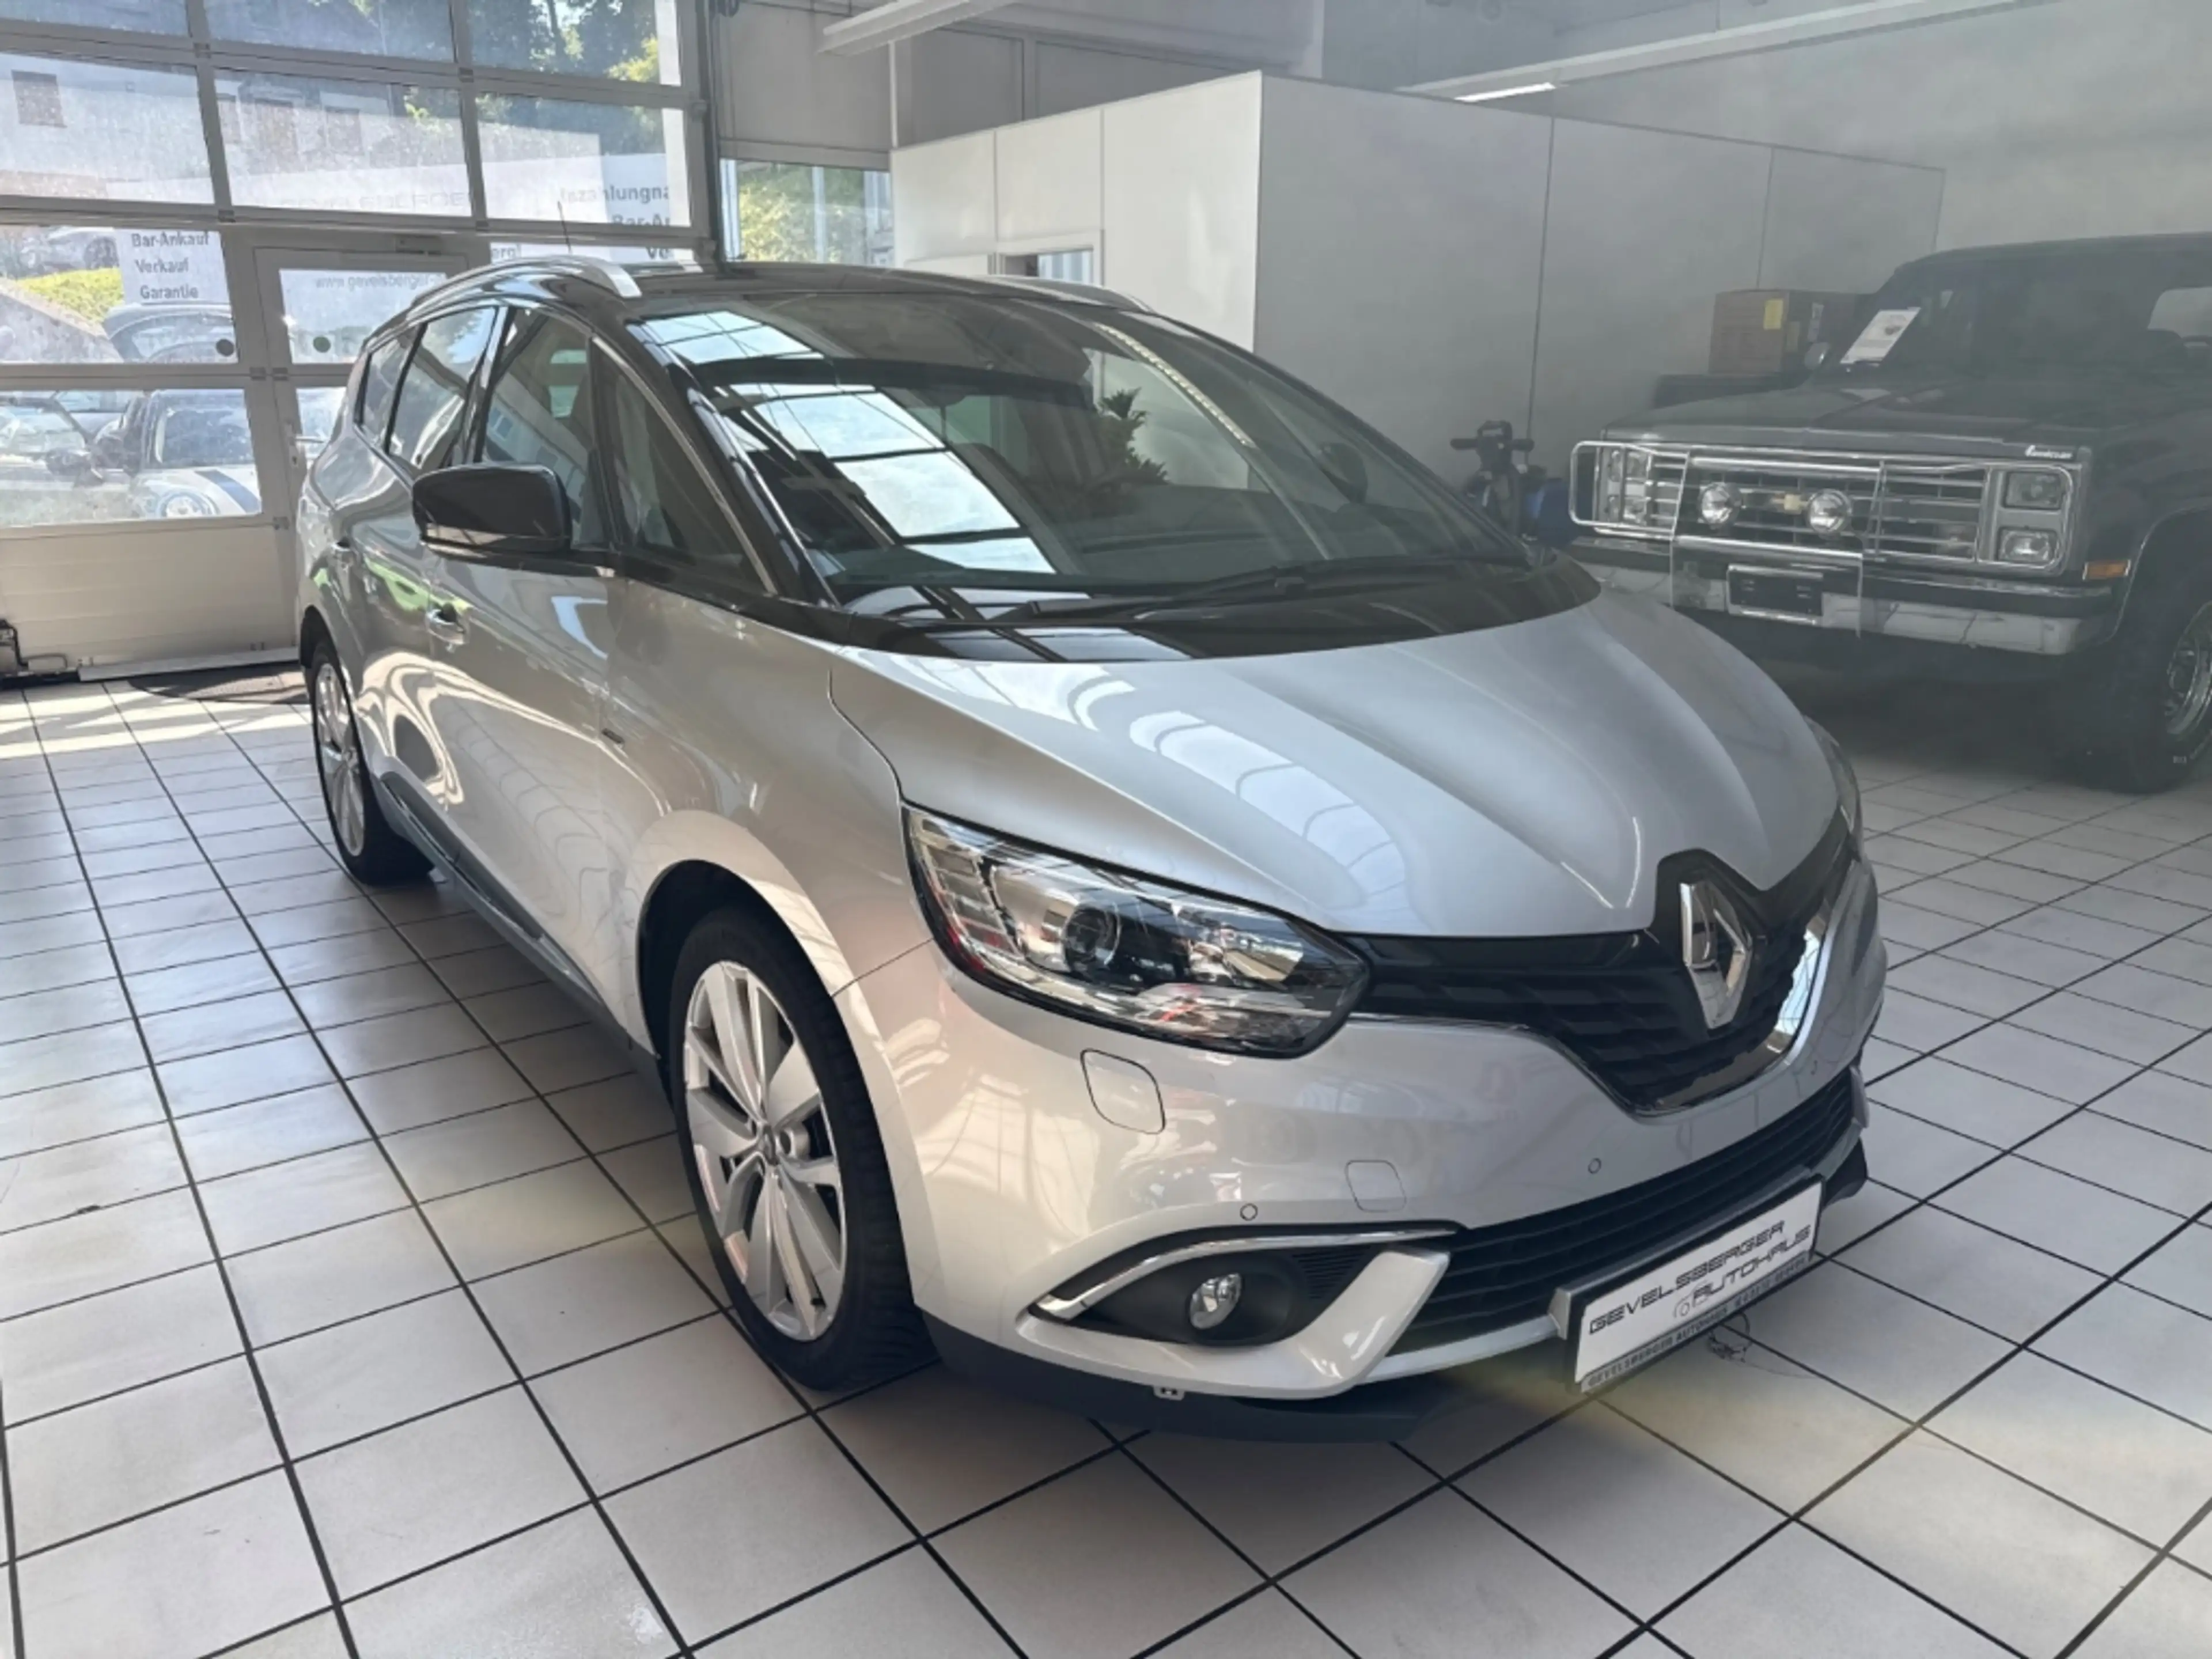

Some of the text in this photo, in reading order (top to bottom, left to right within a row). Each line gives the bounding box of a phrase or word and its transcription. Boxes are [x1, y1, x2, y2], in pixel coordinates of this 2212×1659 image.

[131, 230, 209, 247] Bar-Ankauf
[134, 257, 189, 273] Verkauf
[140, 284, 199, 299] Garantie
[1692, 1224, 1811, 1307] AUTOHAUS
[1589, 1219, 1785, 1335] GEVELSBERGER
